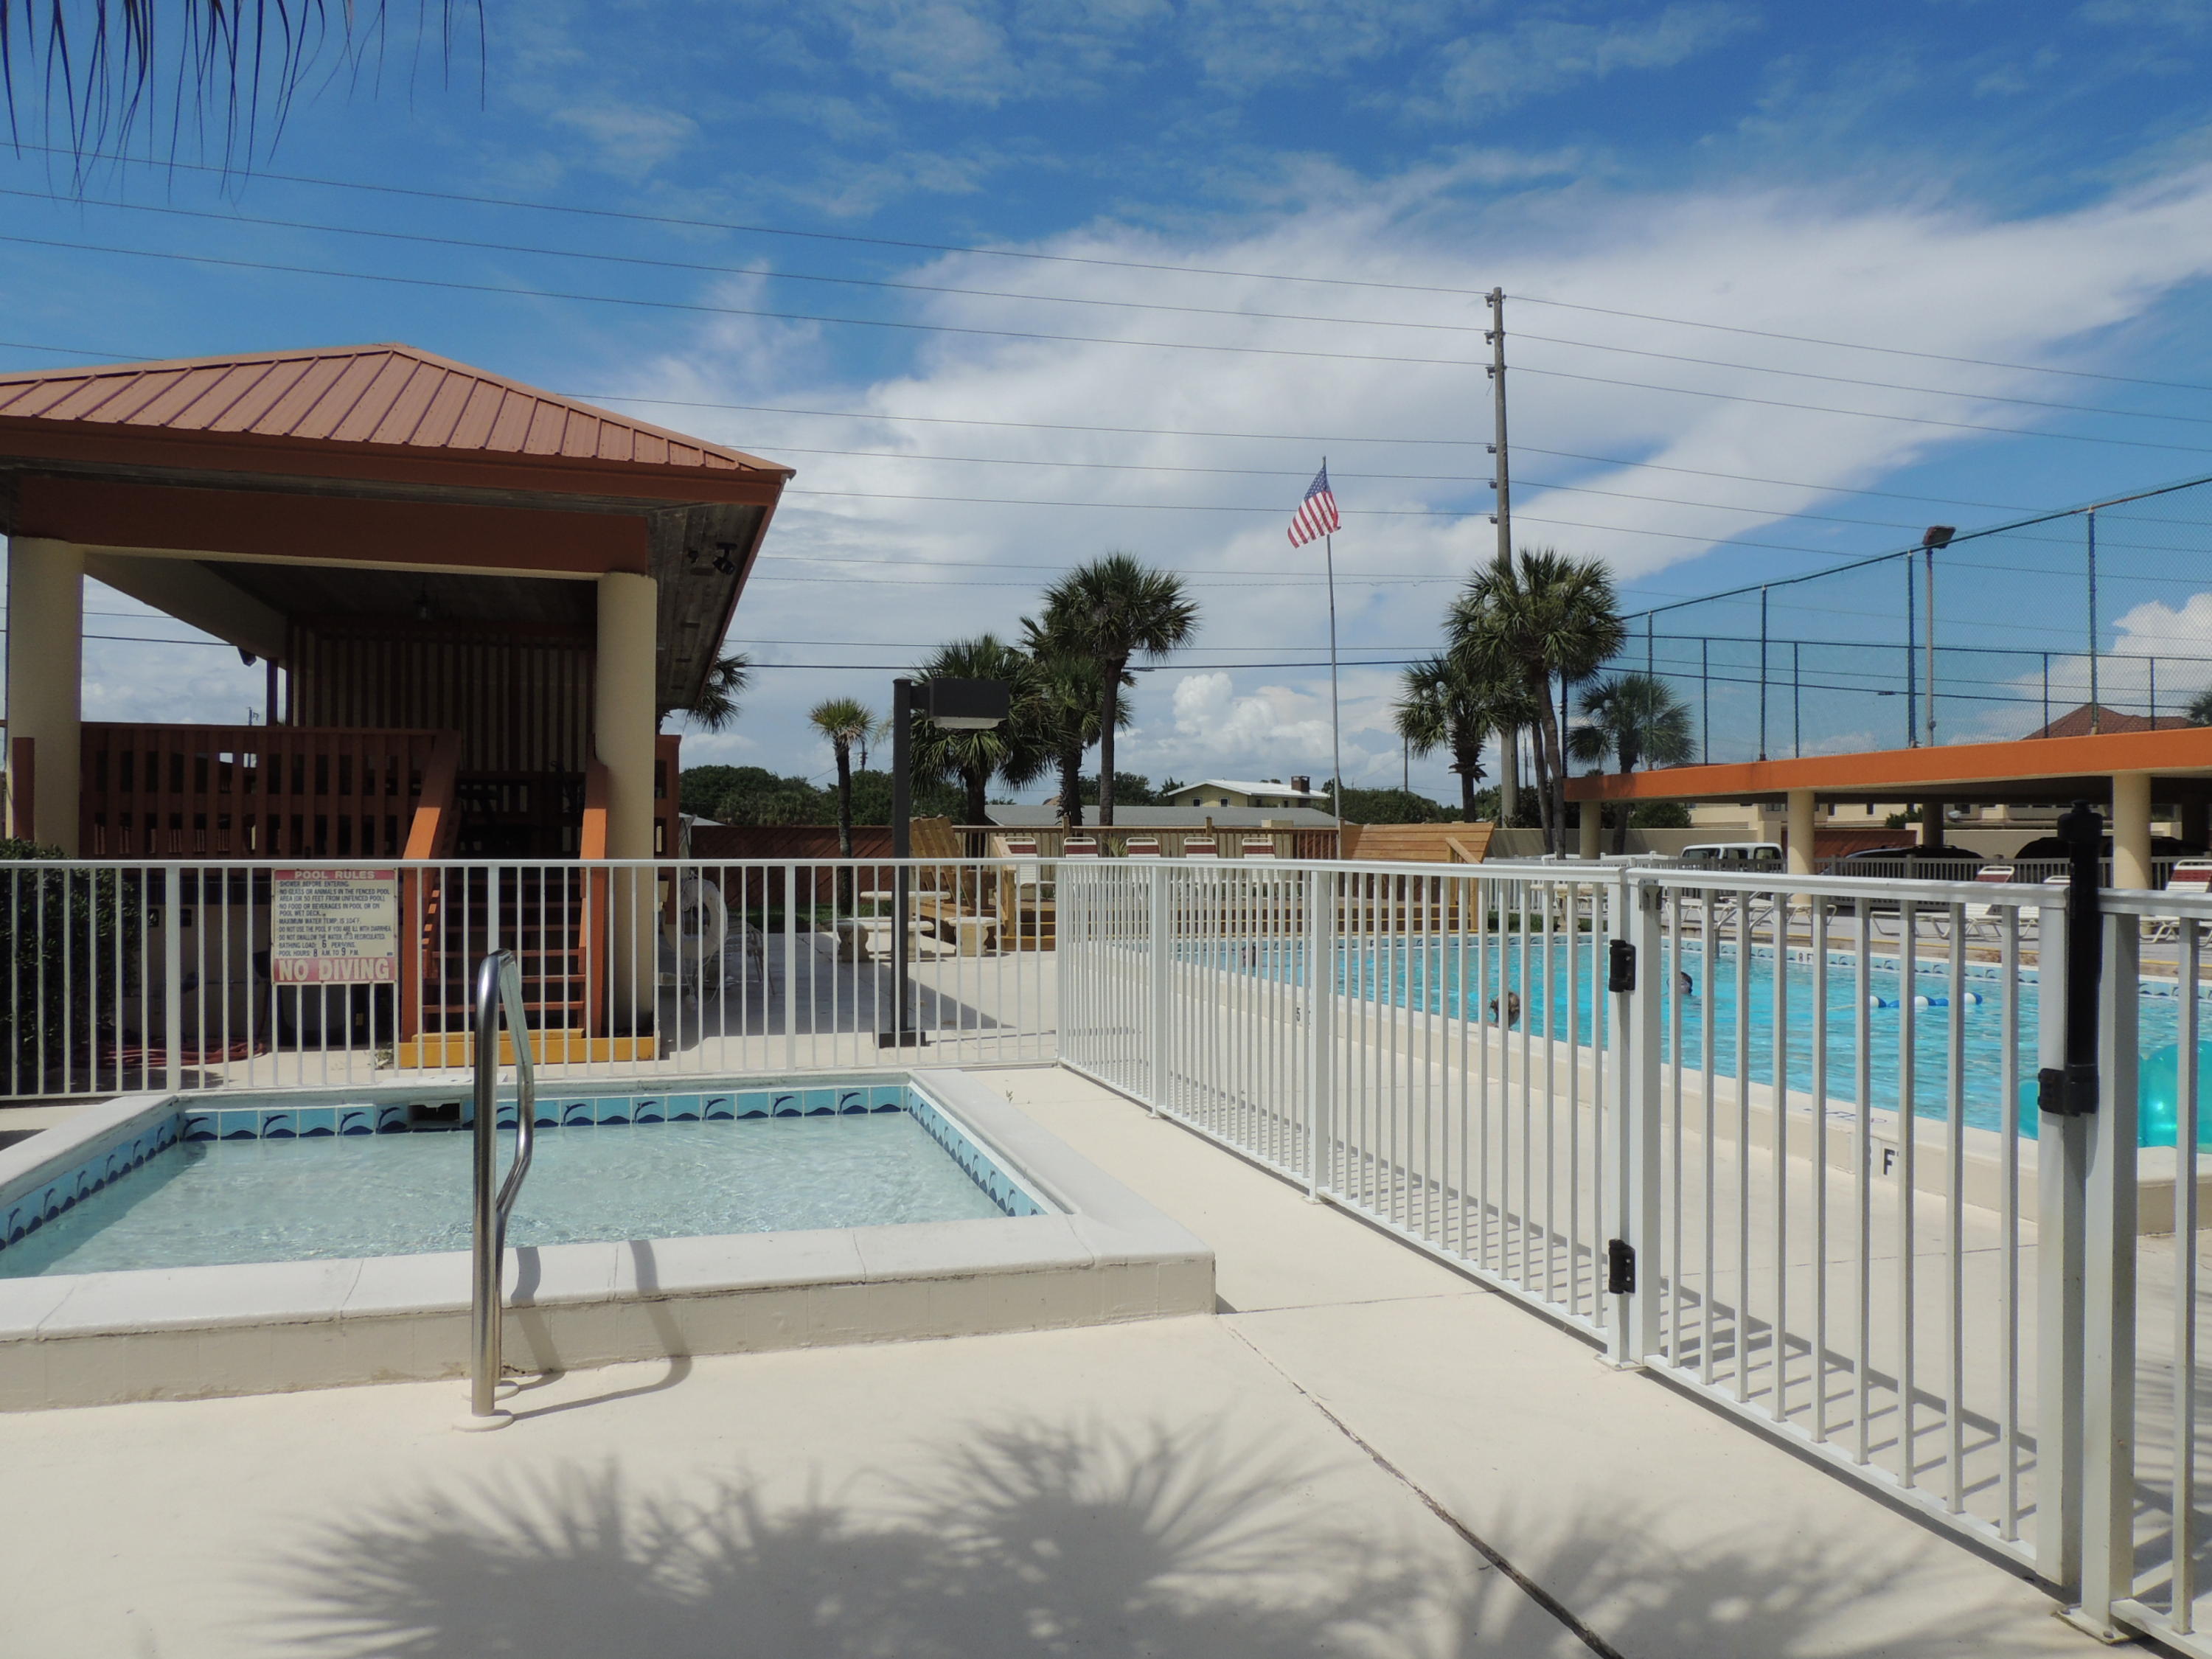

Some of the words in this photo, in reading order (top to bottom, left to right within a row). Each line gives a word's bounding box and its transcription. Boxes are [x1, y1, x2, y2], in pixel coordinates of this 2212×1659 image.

[295, 871, 328, 879] POOL
[335, 871, 375, 879] RULES
[322, 939, 327, 948] 6
[313, 949, 317, 957] 8
[342, 947, 346, 956] 9
[1799, 953, 1803, 961] 8
[279, 959, 309, 981] NO
[319, 958, 389, 980] DIVING
